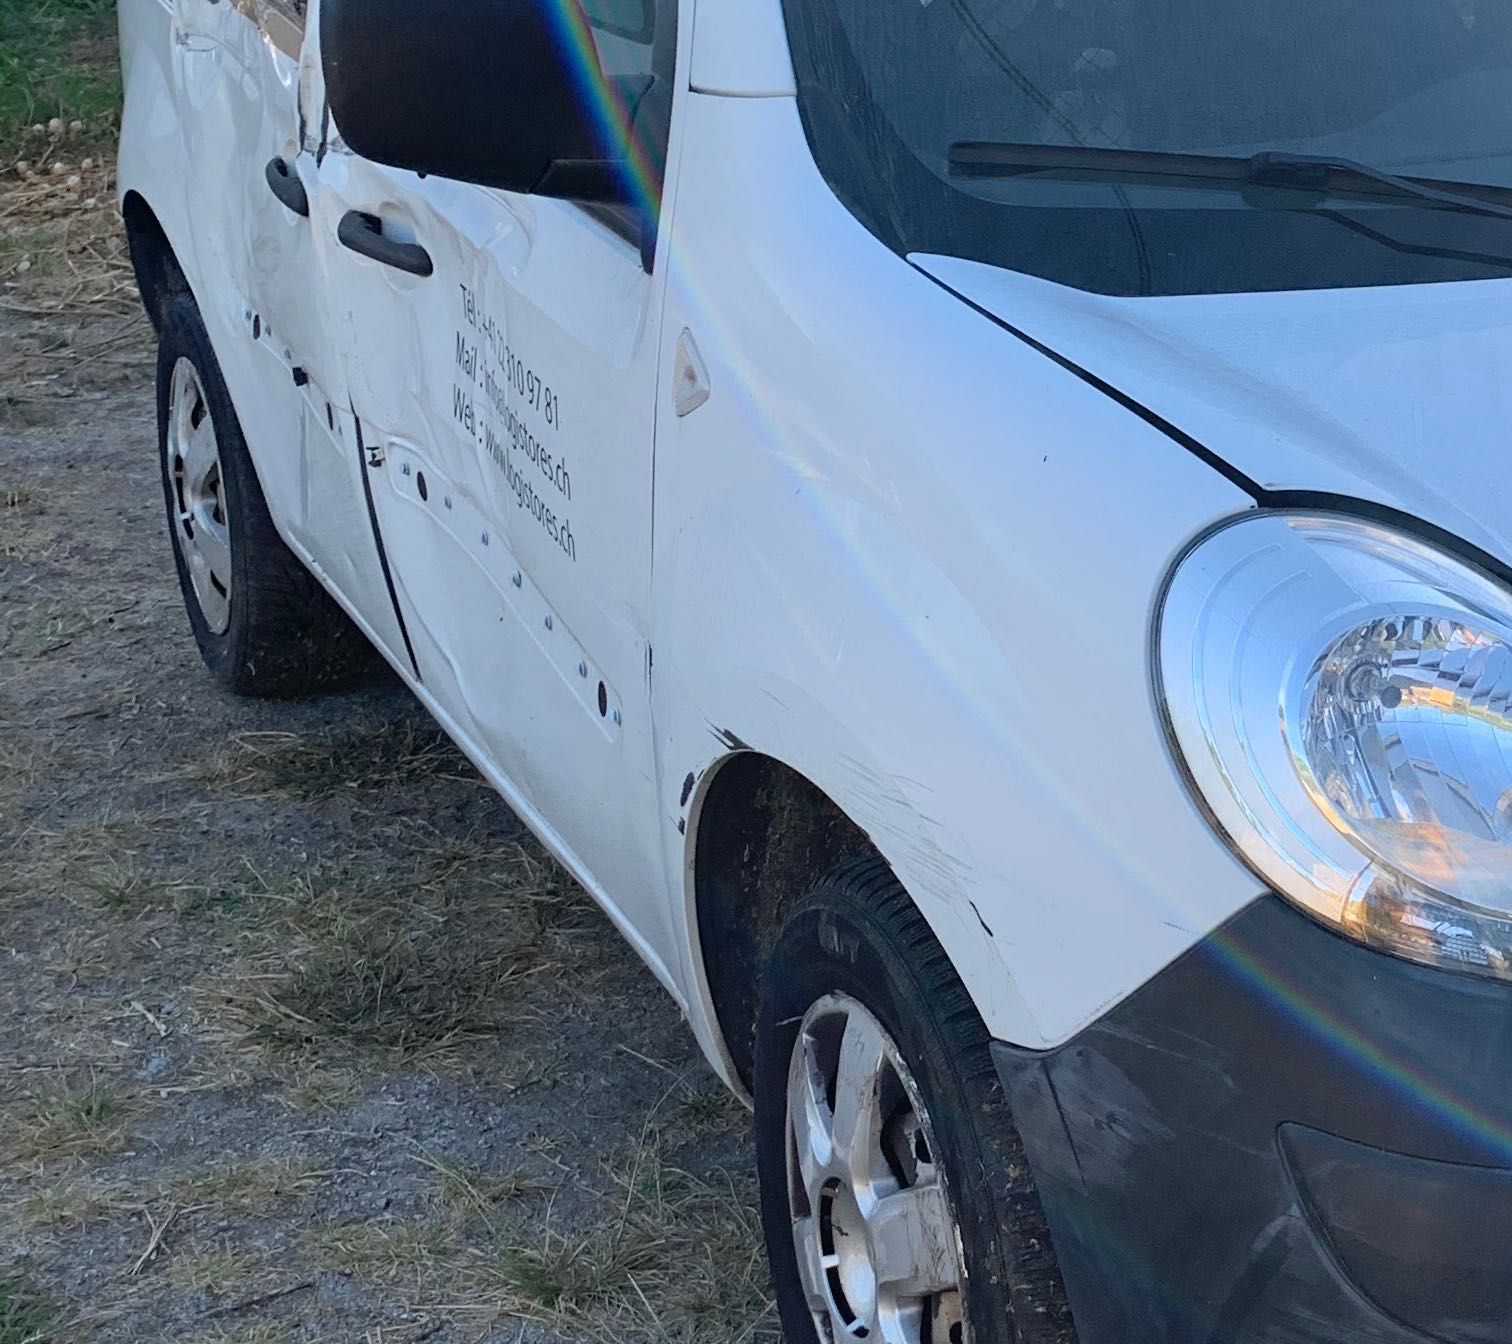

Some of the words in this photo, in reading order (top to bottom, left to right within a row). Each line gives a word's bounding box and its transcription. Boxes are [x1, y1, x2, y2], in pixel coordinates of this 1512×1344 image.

[455, 331, 478, 383] Mail
[459, 283, 476, 328] Tél
[526, 369, 541, 412] 97
[544, 387, 559, 431] 81
